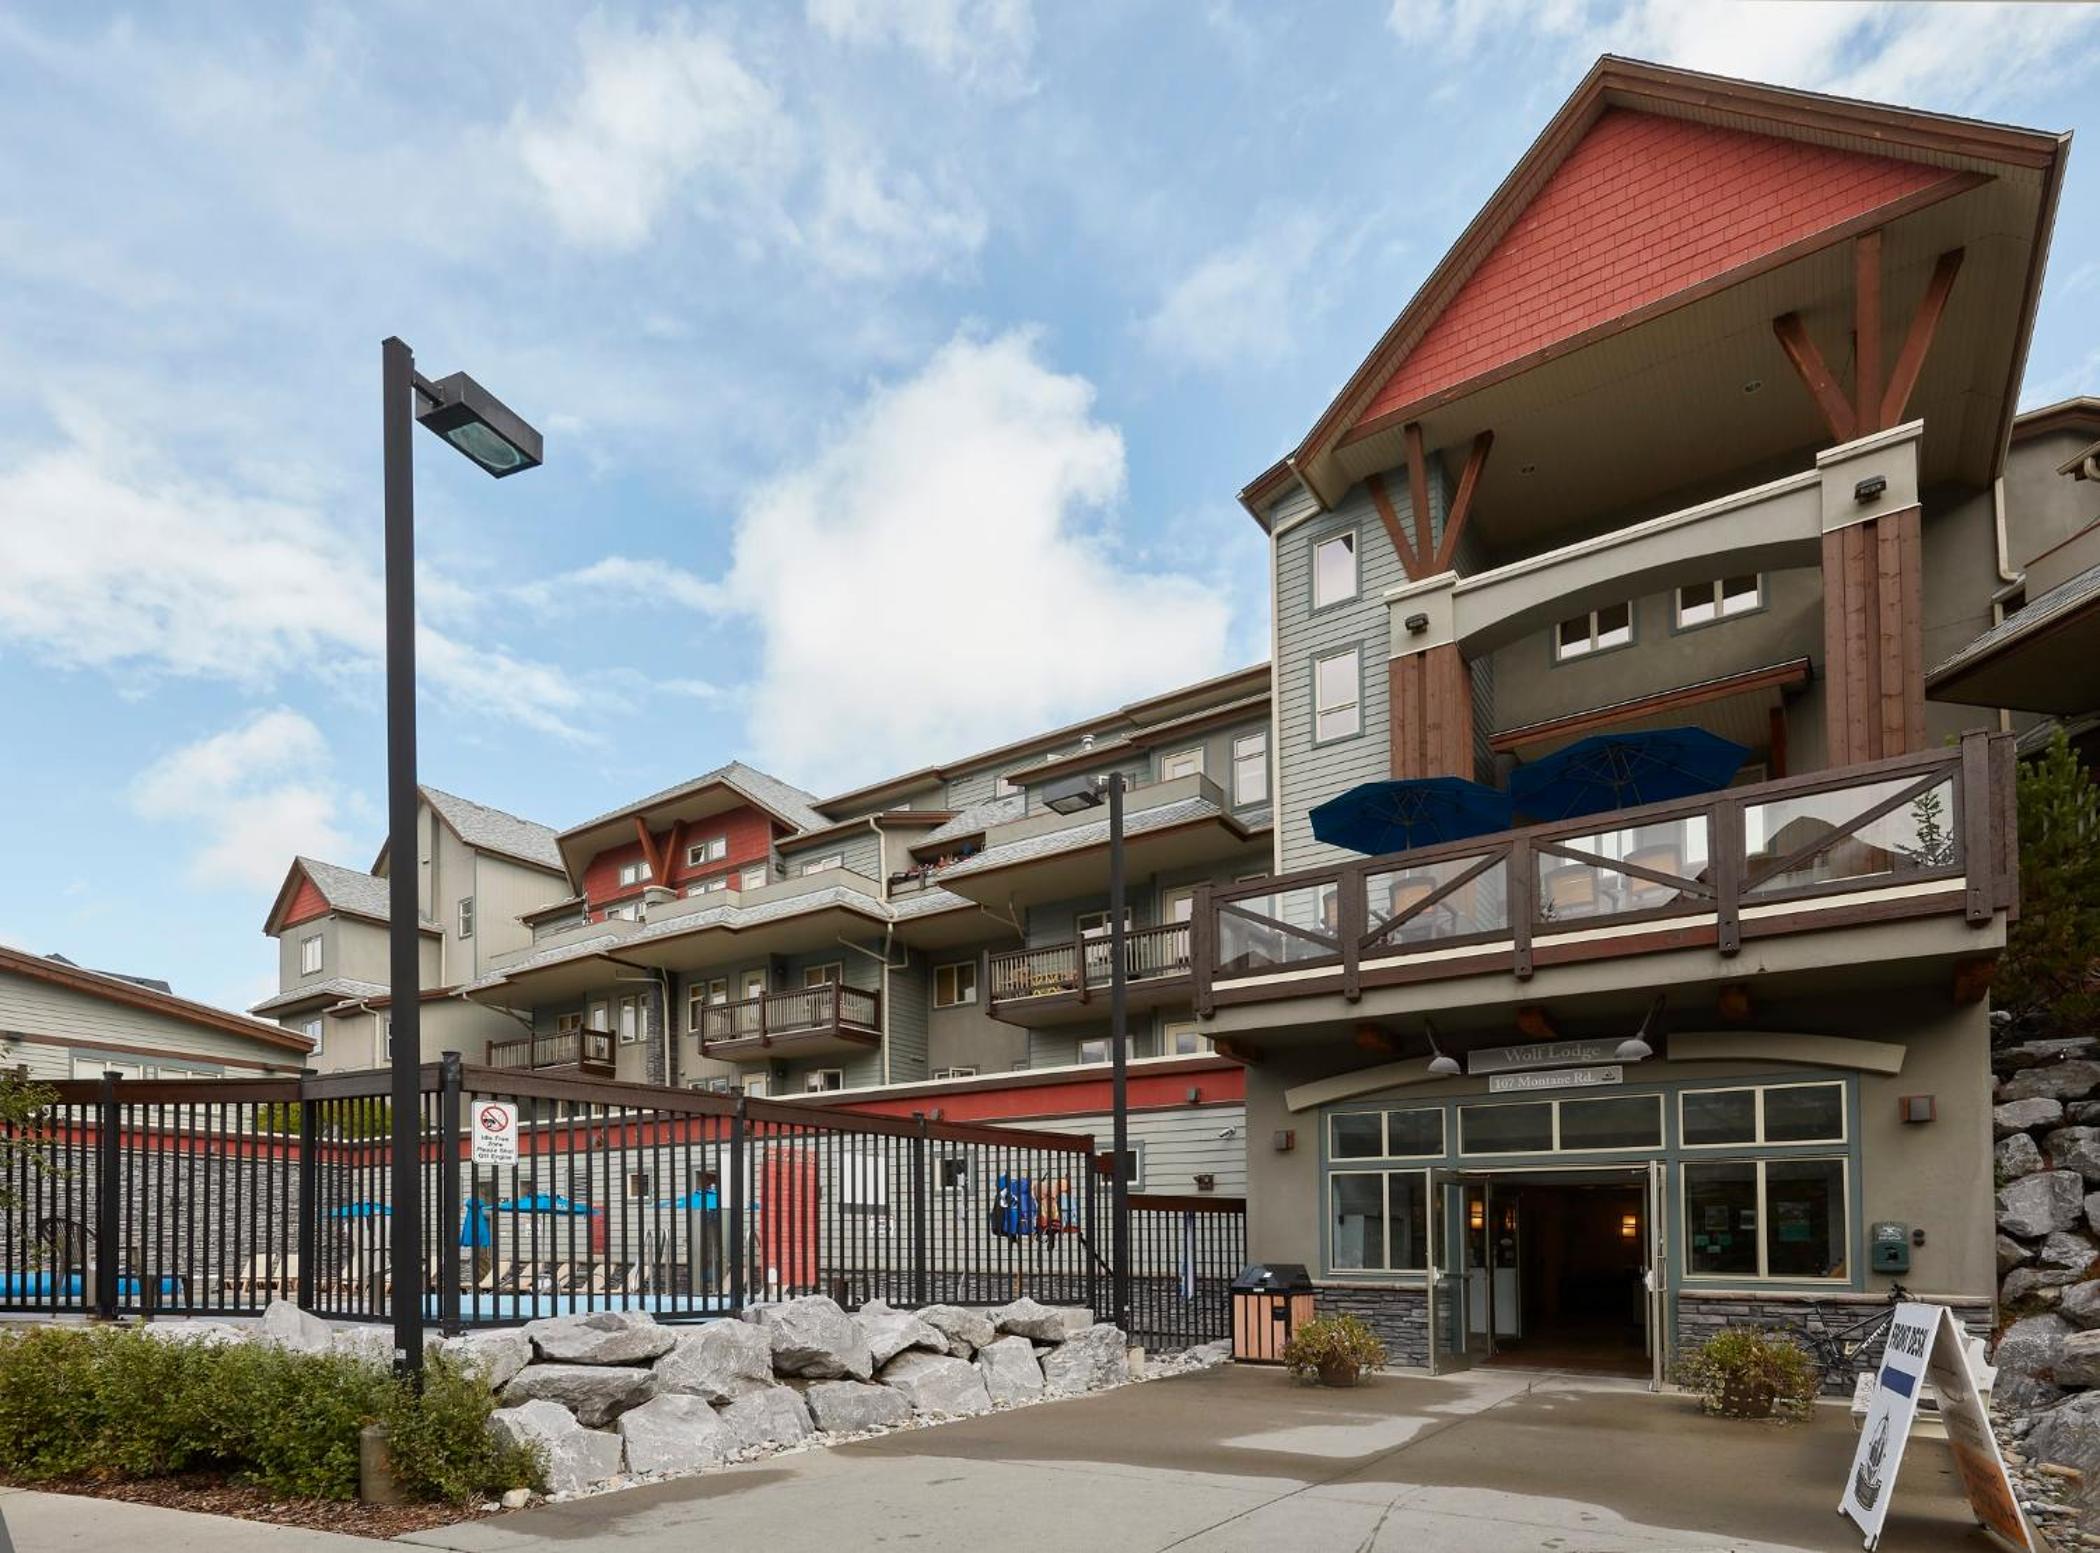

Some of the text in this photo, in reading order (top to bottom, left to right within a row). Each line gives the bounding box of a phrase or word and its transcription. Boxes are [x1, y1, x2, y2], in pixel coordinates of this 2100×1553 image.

[1549, 1042, 1600, 1061] Lodge
[1495, 1071, 1596, 1089] 107 Montane Rd.
